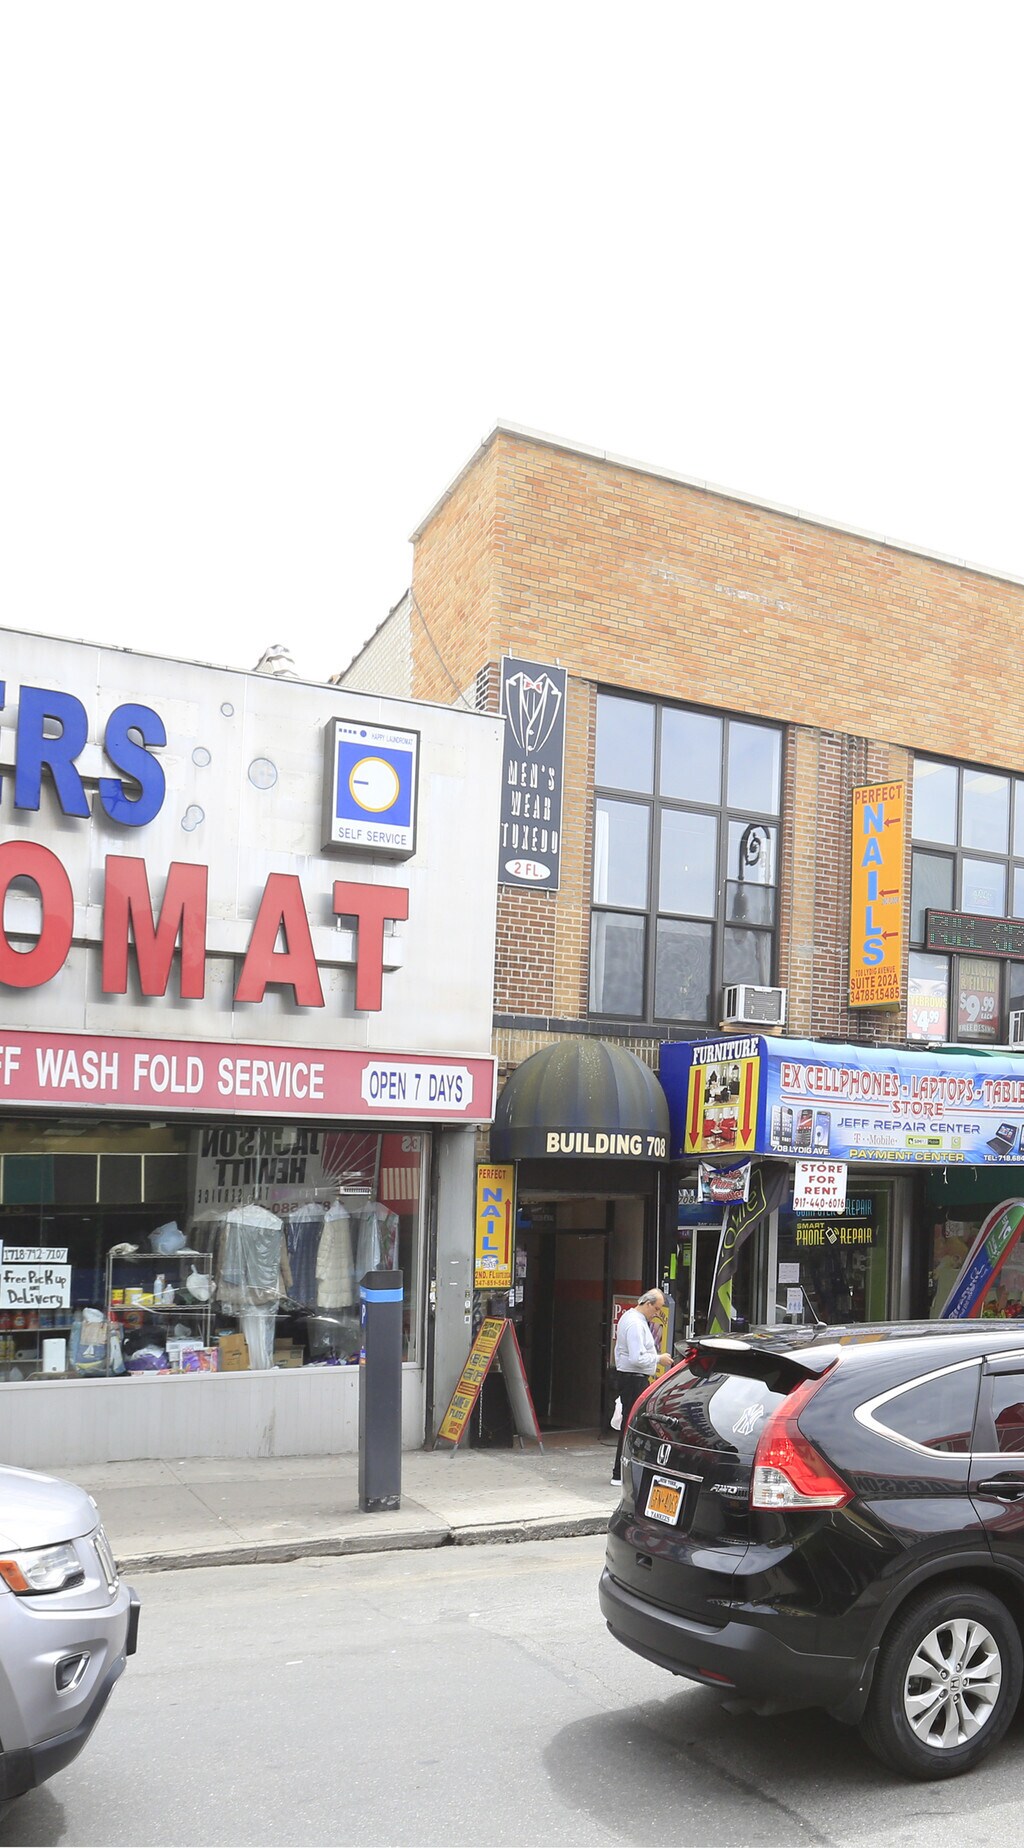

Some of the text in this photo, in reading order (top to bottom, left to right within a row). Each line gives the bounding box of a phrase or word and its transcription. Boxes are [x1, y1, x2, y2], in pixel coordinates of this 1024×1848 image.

[0, 681, 168, 828] RS
[508, 760, 555, 790] MEN'S
[854, 785, 903, 805] PERFECT
[511, 791, 552, 821] WEAR
[338, 827, 407, 845] SELF SERVICE
[501, 823, 559, 854] TUXEDO
[514, 862, 522, 874] 2
[861, 803, 886, 966] NAILS
[850, 973, 899, 990] SUITE 202A
[969, 977, 985, 992] FILL
[986, 978, 996, 993] IN
[692, 1037, 760, 1066] FURNITURE
[36, 1048, 118, 1091] WASH
[134, 1054, 203, 1094] FOLD
[218, 1058, 325, 1099] SERVICE
[781, 1063, 802, 1090] EX
[804, 1065, 900, 1098] CELLPHONES
[911, 1076, 974, 1102] LAPTOPS
[370, 1069, 463, 1103] OPEN 7 DAYS
[892, 1101, 944, 1117] STORE
[837, 1117, 981, 1134] JEFF REPAIR CENTER
[546, 1132, 667, 1158] BUILDING 708
[772, 1144, 831, 1155] 708 LYDIG AVE.
[849, 1149, 965, 1162] PAYMENT CENTER
[478, 1168, 506, 1179] PERFECT
[801, 1164, 843, 1173] STORE
[808, 1175, 835, 1184] FOR
[804, 1186, 838, 1195] RENT
[845, 1199, 873, 1216] REPAIR
[796, 1227, 873, 1246] PHONE REPAIR
[3, 1270, 27, 1283] Free
[55, 1276, 67, 1289] up
